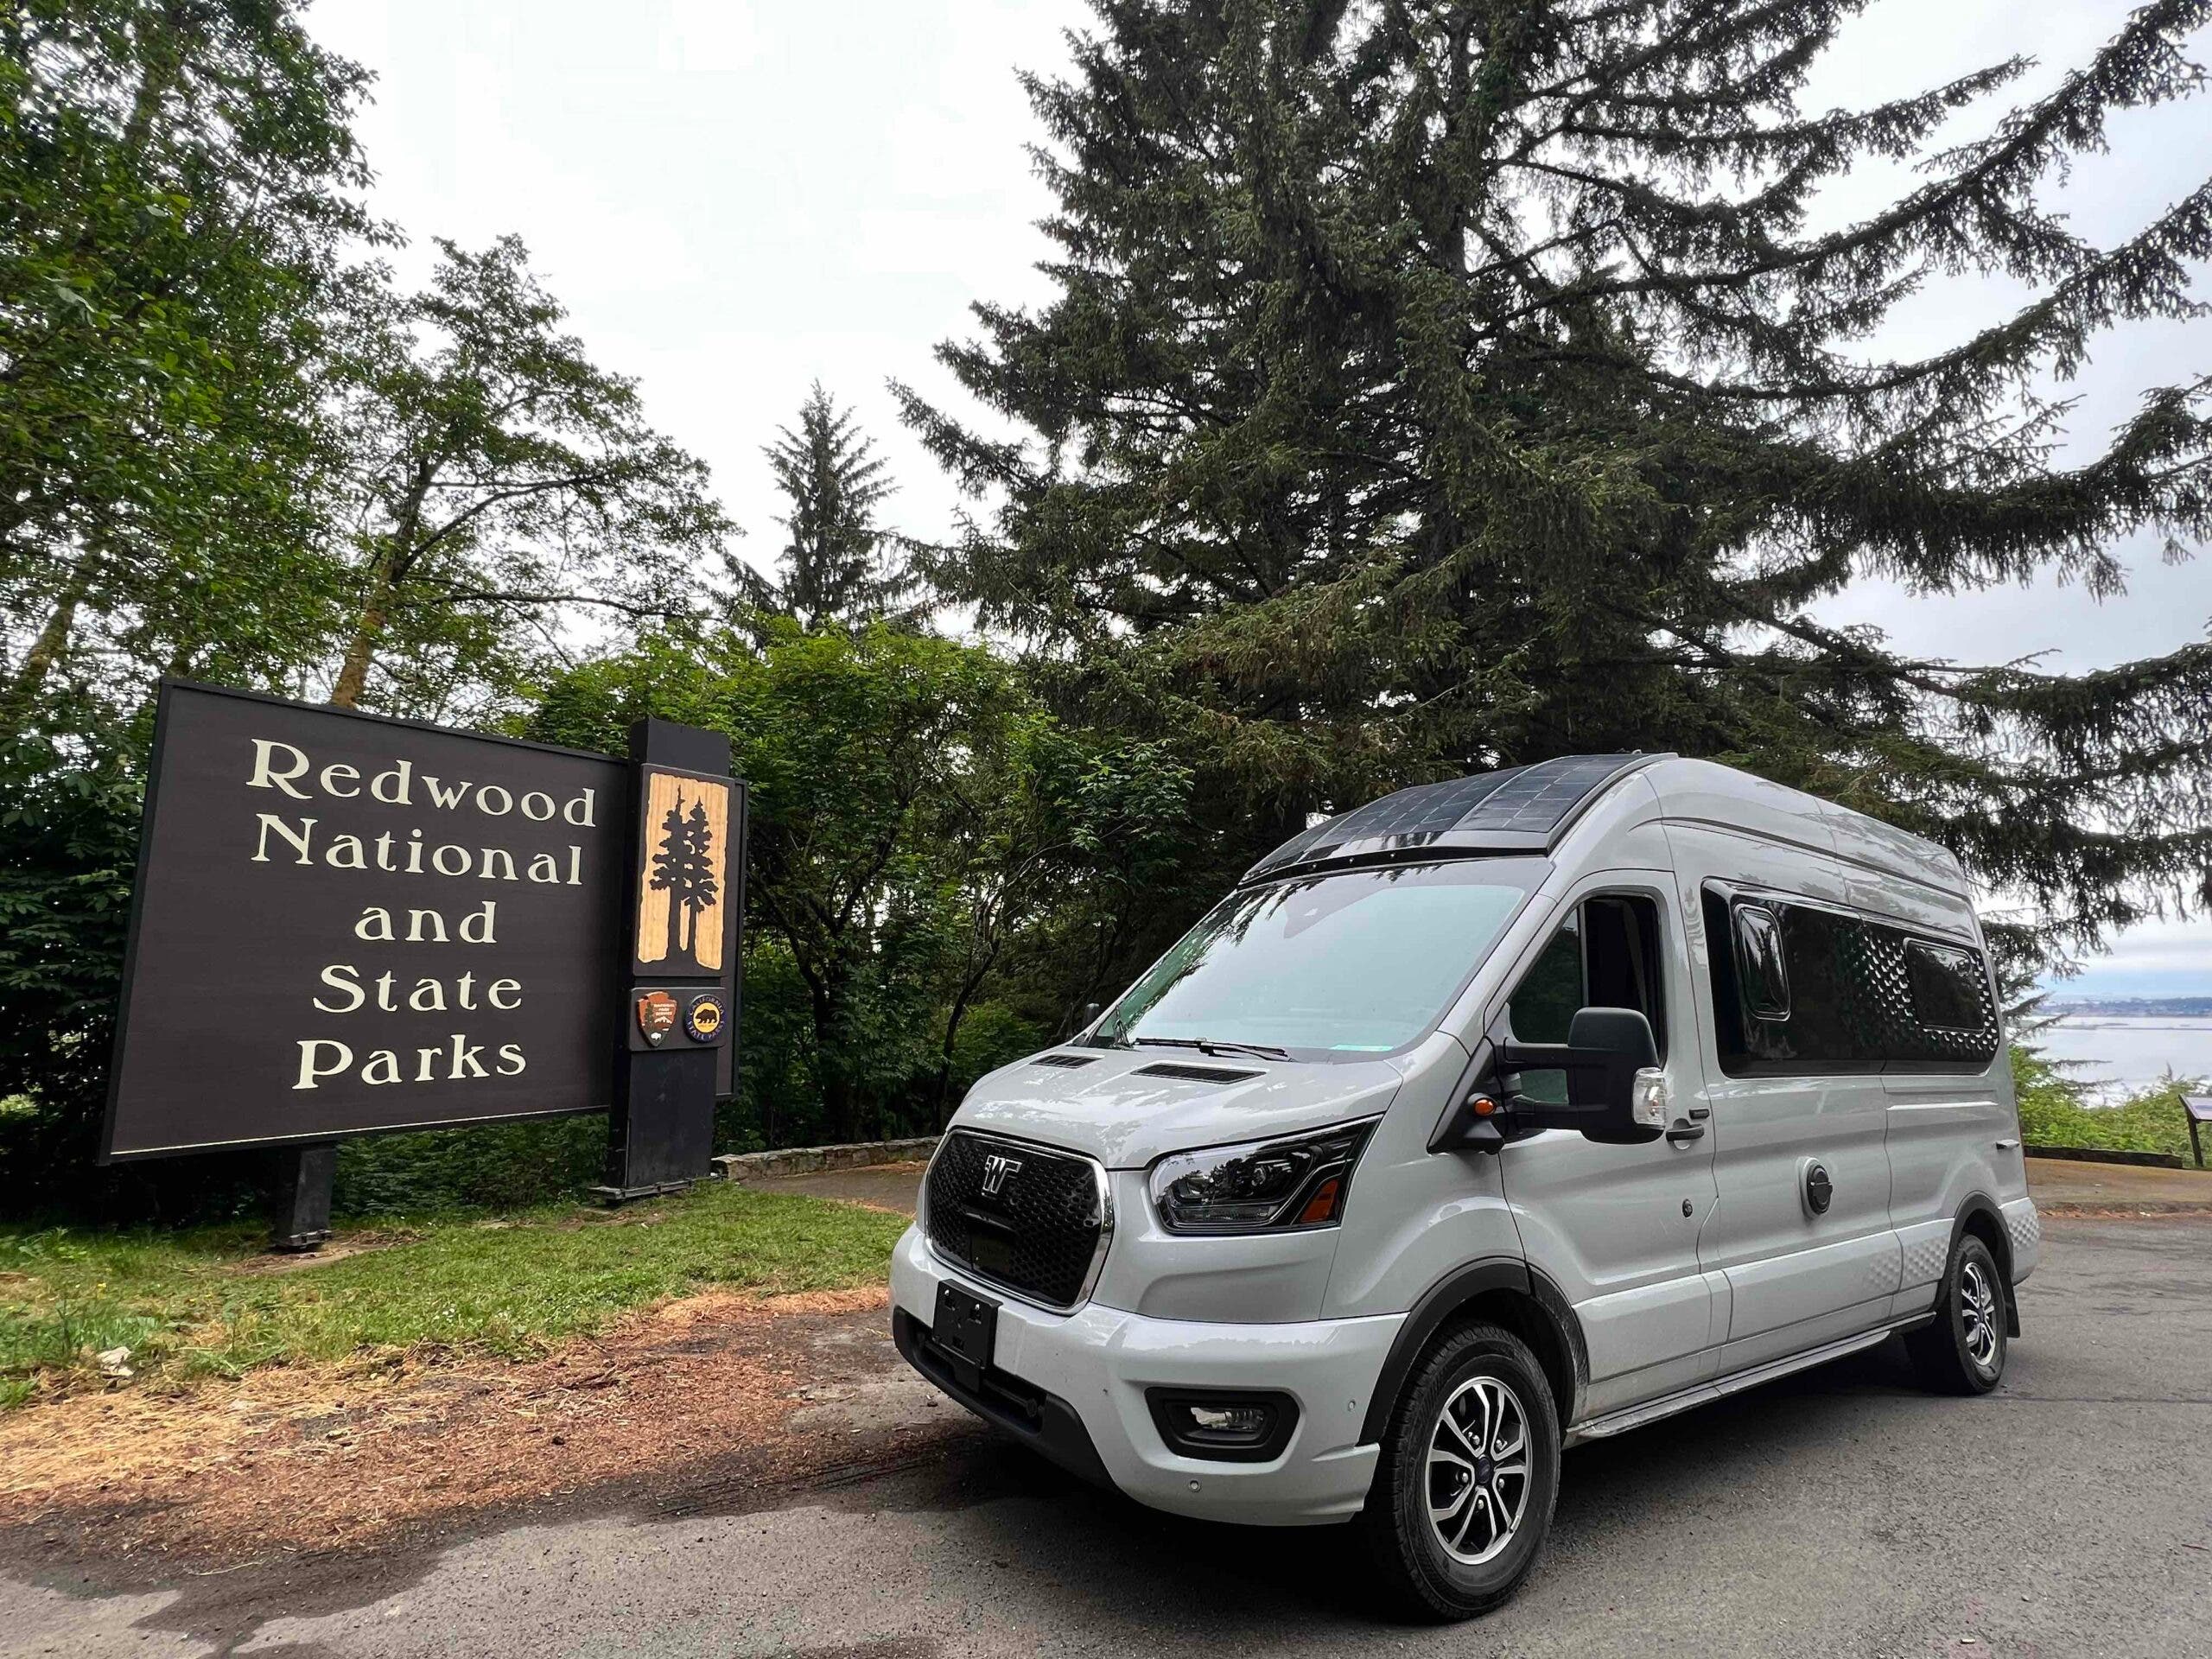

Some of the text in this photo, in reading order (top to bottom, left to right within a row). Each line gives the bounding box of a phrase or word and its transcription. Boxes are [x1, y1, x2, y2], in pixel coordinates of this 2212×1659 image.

[245, 738, 596, 828] Redwood
[251, 813, 582, 886] National
[354, 900, 498, 944] and
[312, 964, 522, 1014] State
[690, 996, 724, 1015] CALIFORNIA
[291, 1033, 526, 1090] Parks
